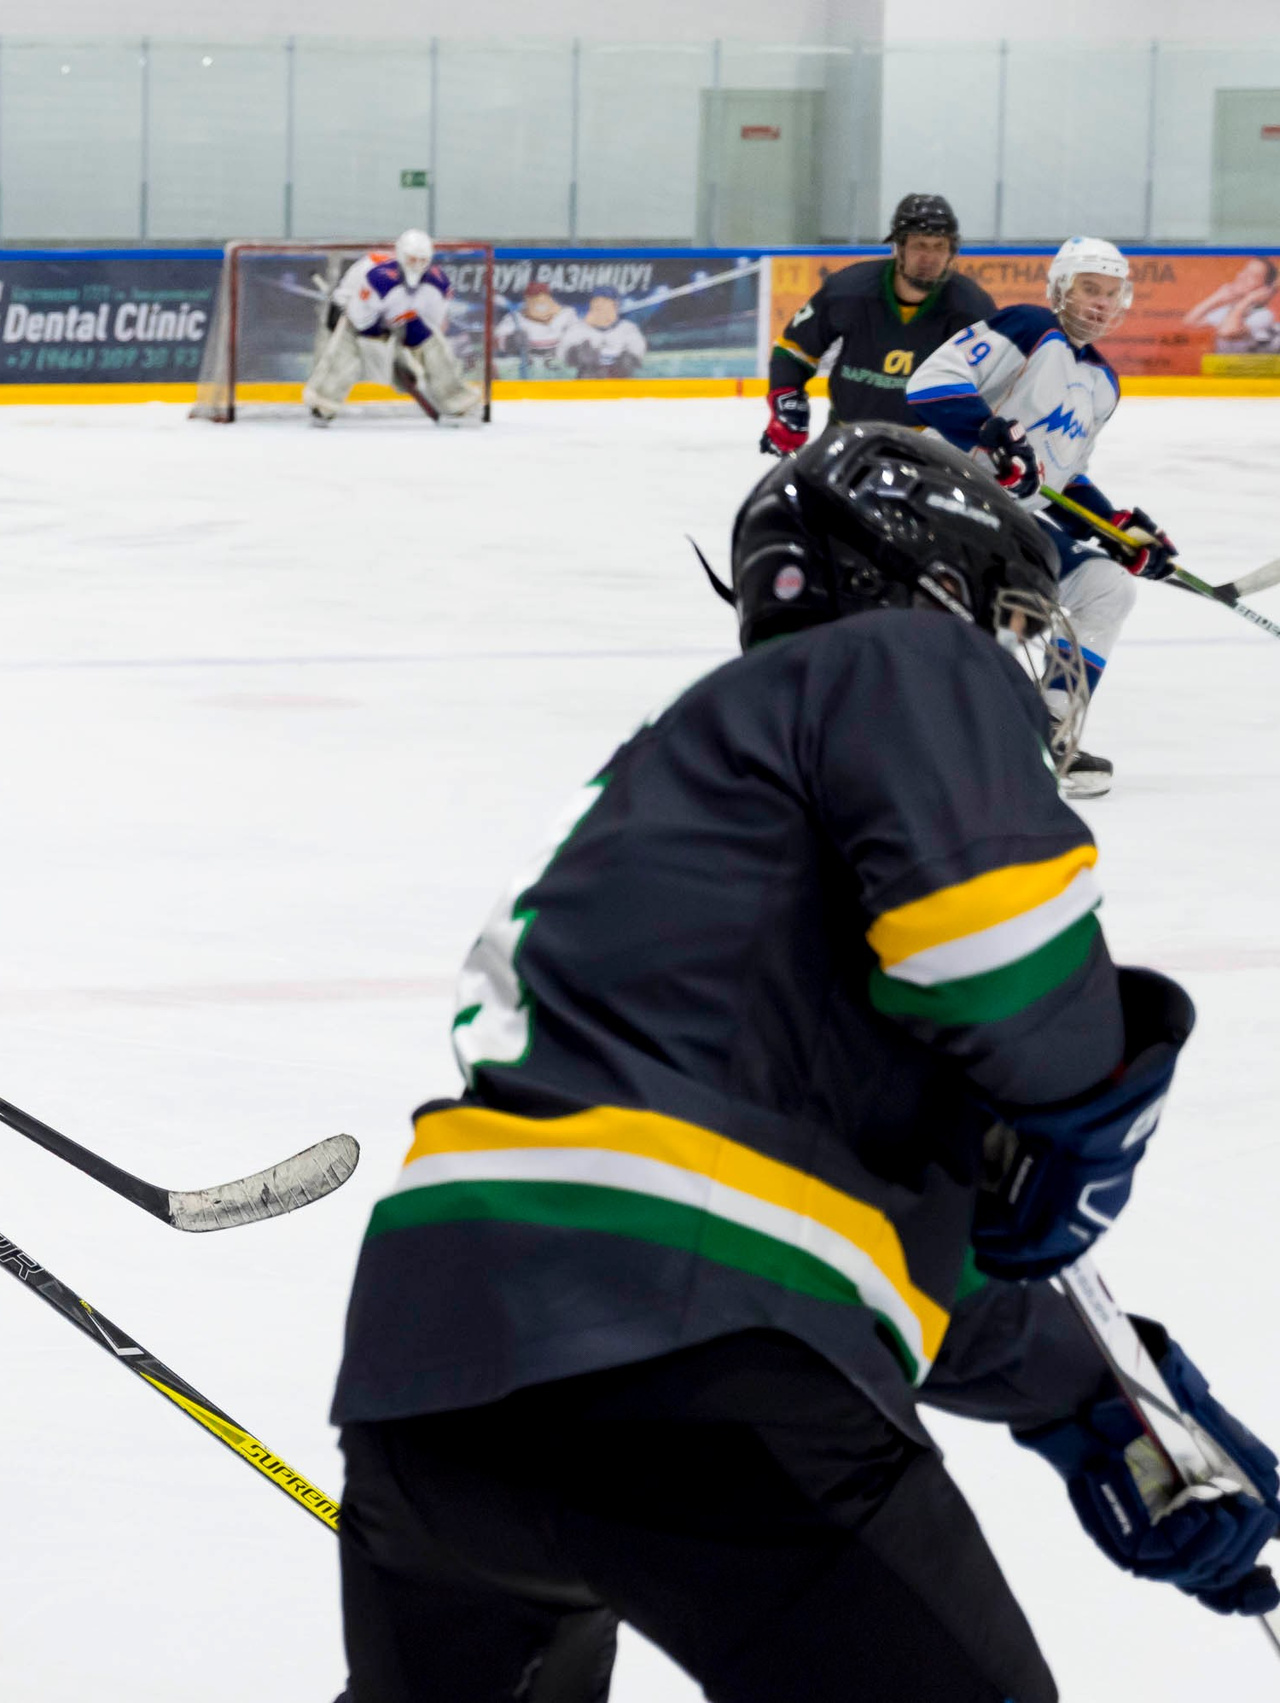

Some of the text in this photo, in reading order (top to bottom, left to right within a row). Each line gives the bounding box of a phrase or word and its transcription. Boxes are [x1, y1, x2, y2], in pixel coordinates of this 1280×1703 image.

[3, 303, 111, 344] Dental
[114, 302, 207, 342] Clinic
[240, 1443, 341, 1520] SUPREM
